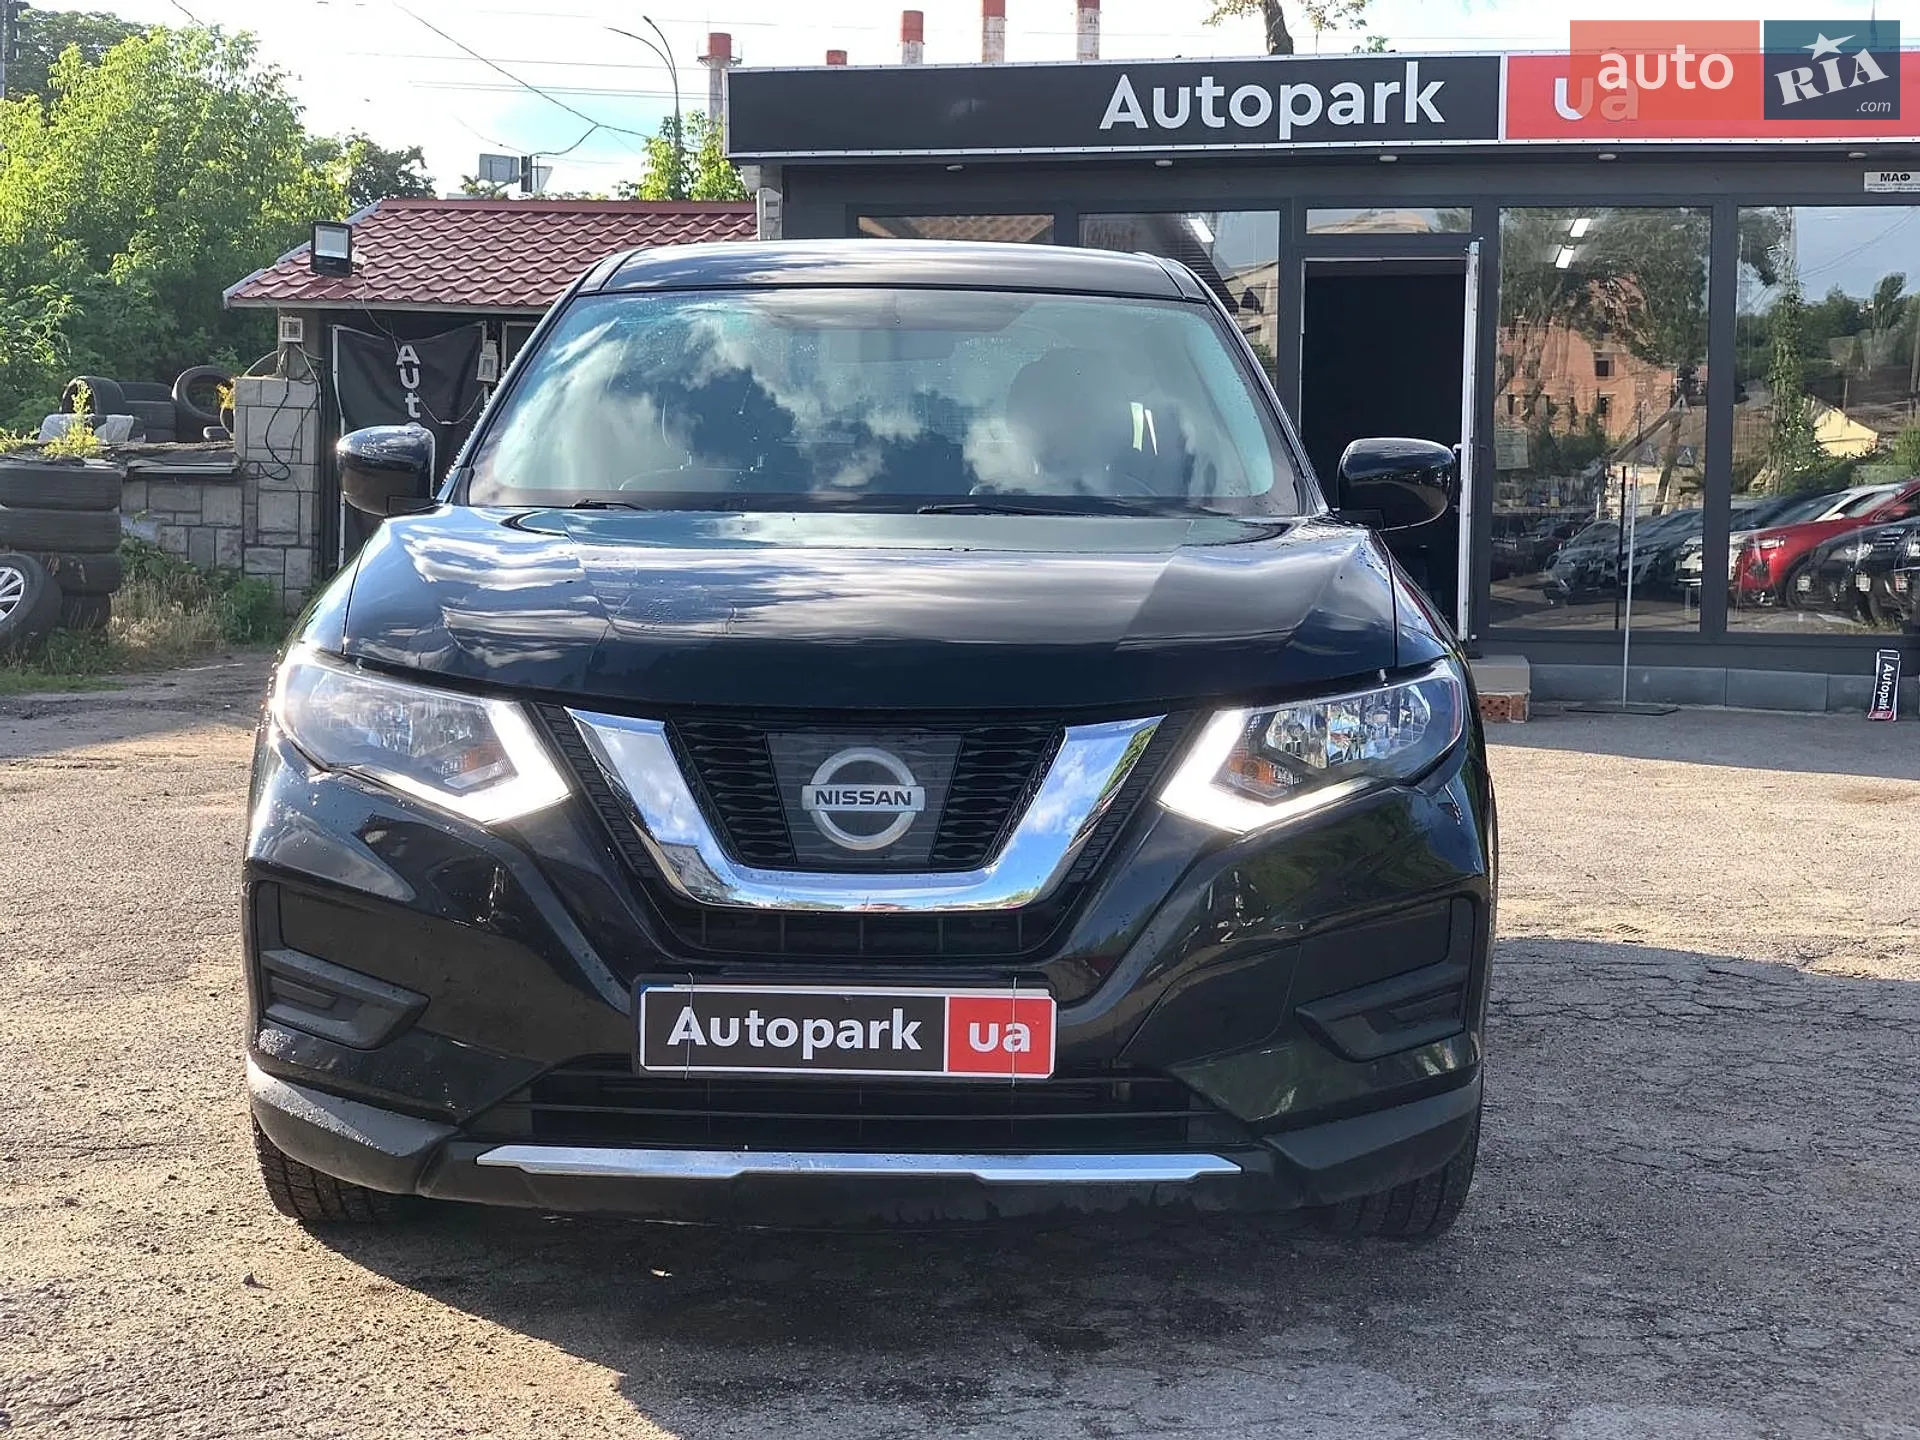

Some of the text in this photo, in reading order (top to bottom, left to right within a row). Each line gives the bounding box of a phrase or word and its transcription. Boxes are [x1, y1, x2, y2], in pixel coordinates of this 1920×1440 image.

[1099, 61, 1446, 141] Autopark
[396, 344, 421, 426] Aut
[815, 790, 912, 806] NISSAN
[667, 1006, 1031, 1060] Autopark ua
